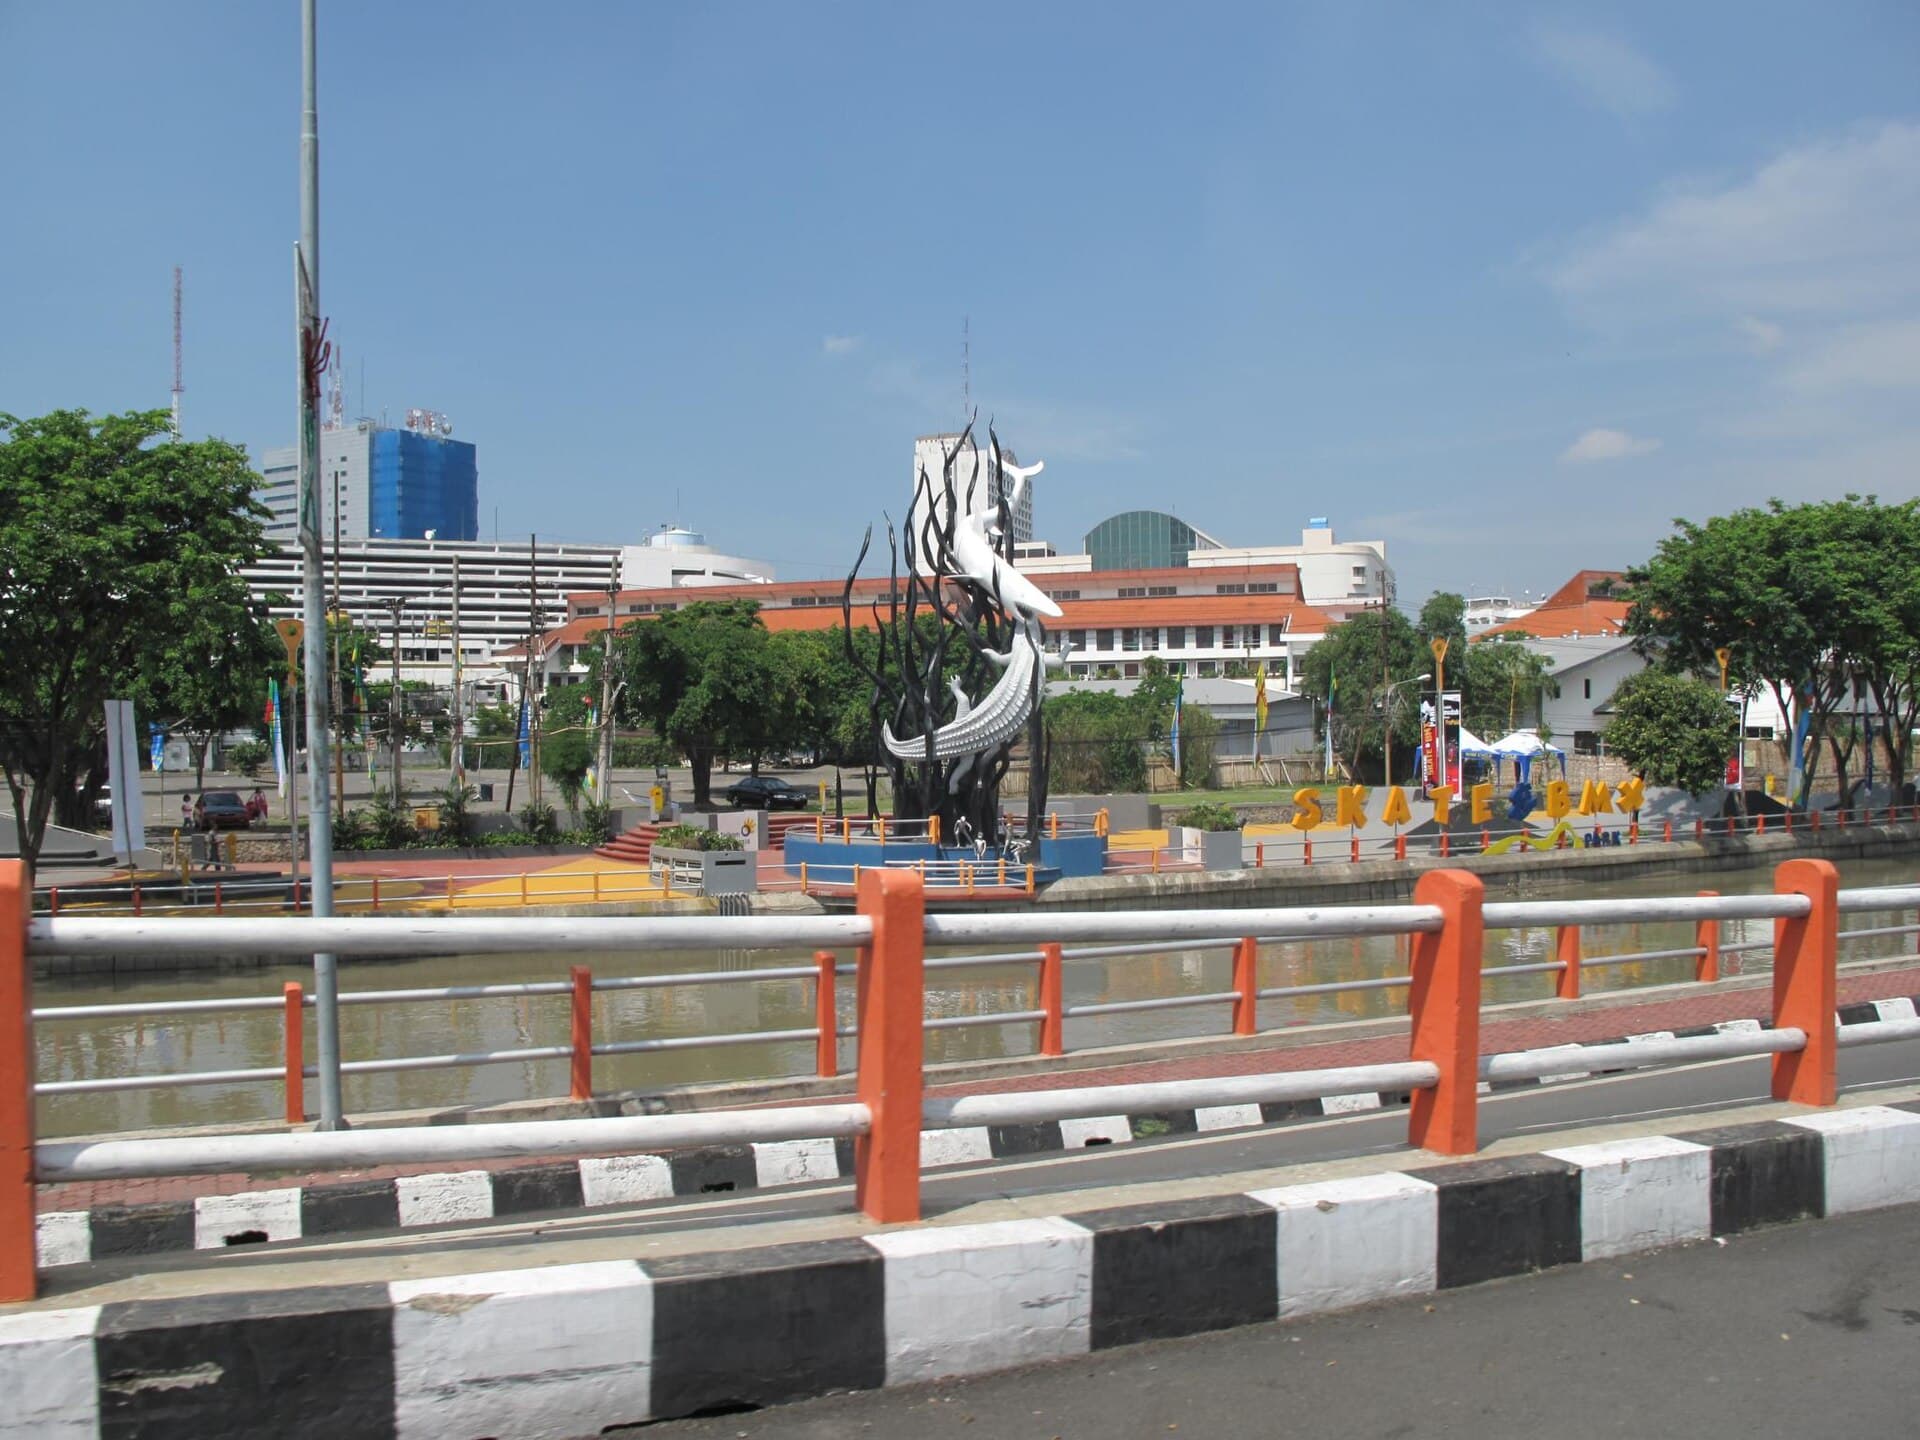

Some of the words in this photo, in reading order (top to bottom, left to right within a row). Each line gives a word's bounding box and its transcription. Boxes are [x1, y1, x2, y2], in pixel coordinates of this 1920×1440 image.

[1291, 784, 1494, 830] SKATE
[1547, 777, 1645, 818] BMX
[1584, 831, 1622, 848] PARK
